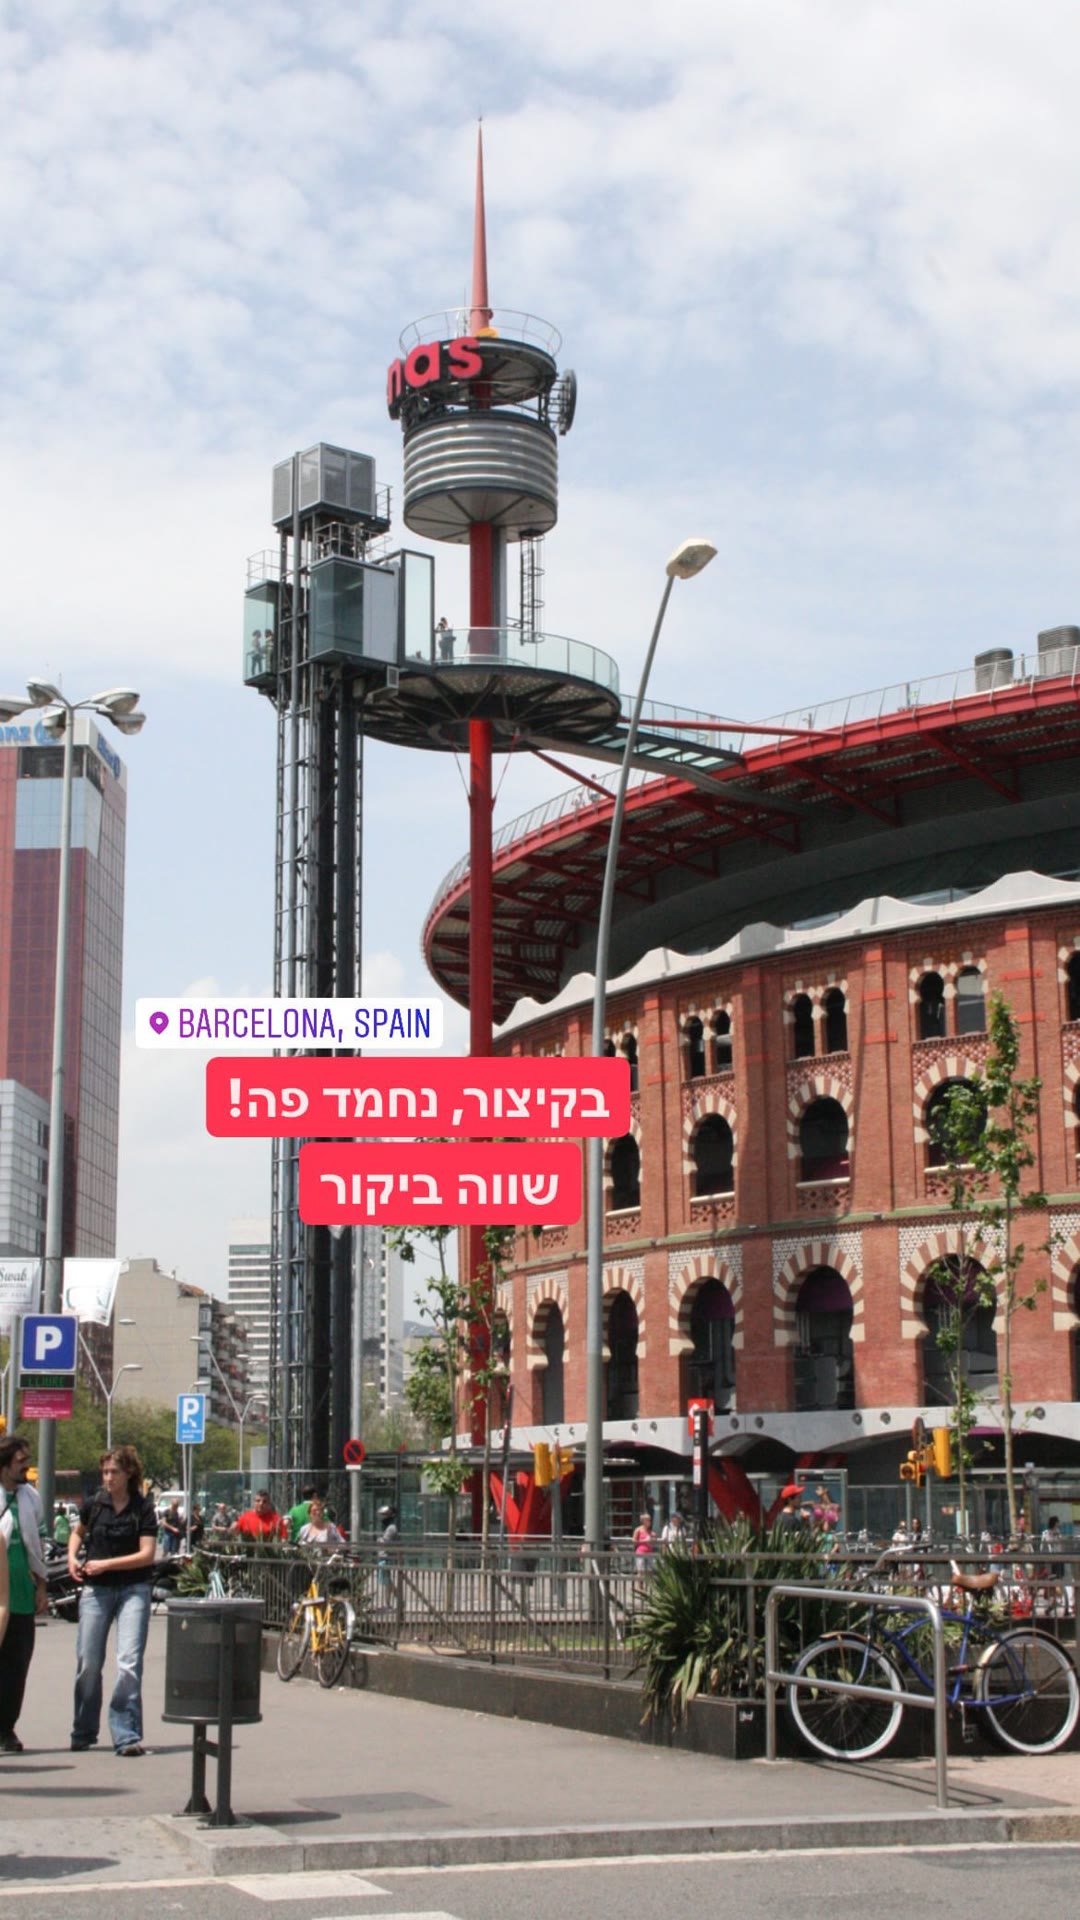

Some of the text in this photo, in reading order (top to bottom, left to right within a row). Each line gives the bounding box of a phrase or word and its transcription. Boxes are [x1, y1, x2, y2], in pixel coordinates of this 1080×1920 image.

[387, 337, 483, 405] nas
[34, 1325, 63, 1361] P
[182, 1397, 200, 1425] P
